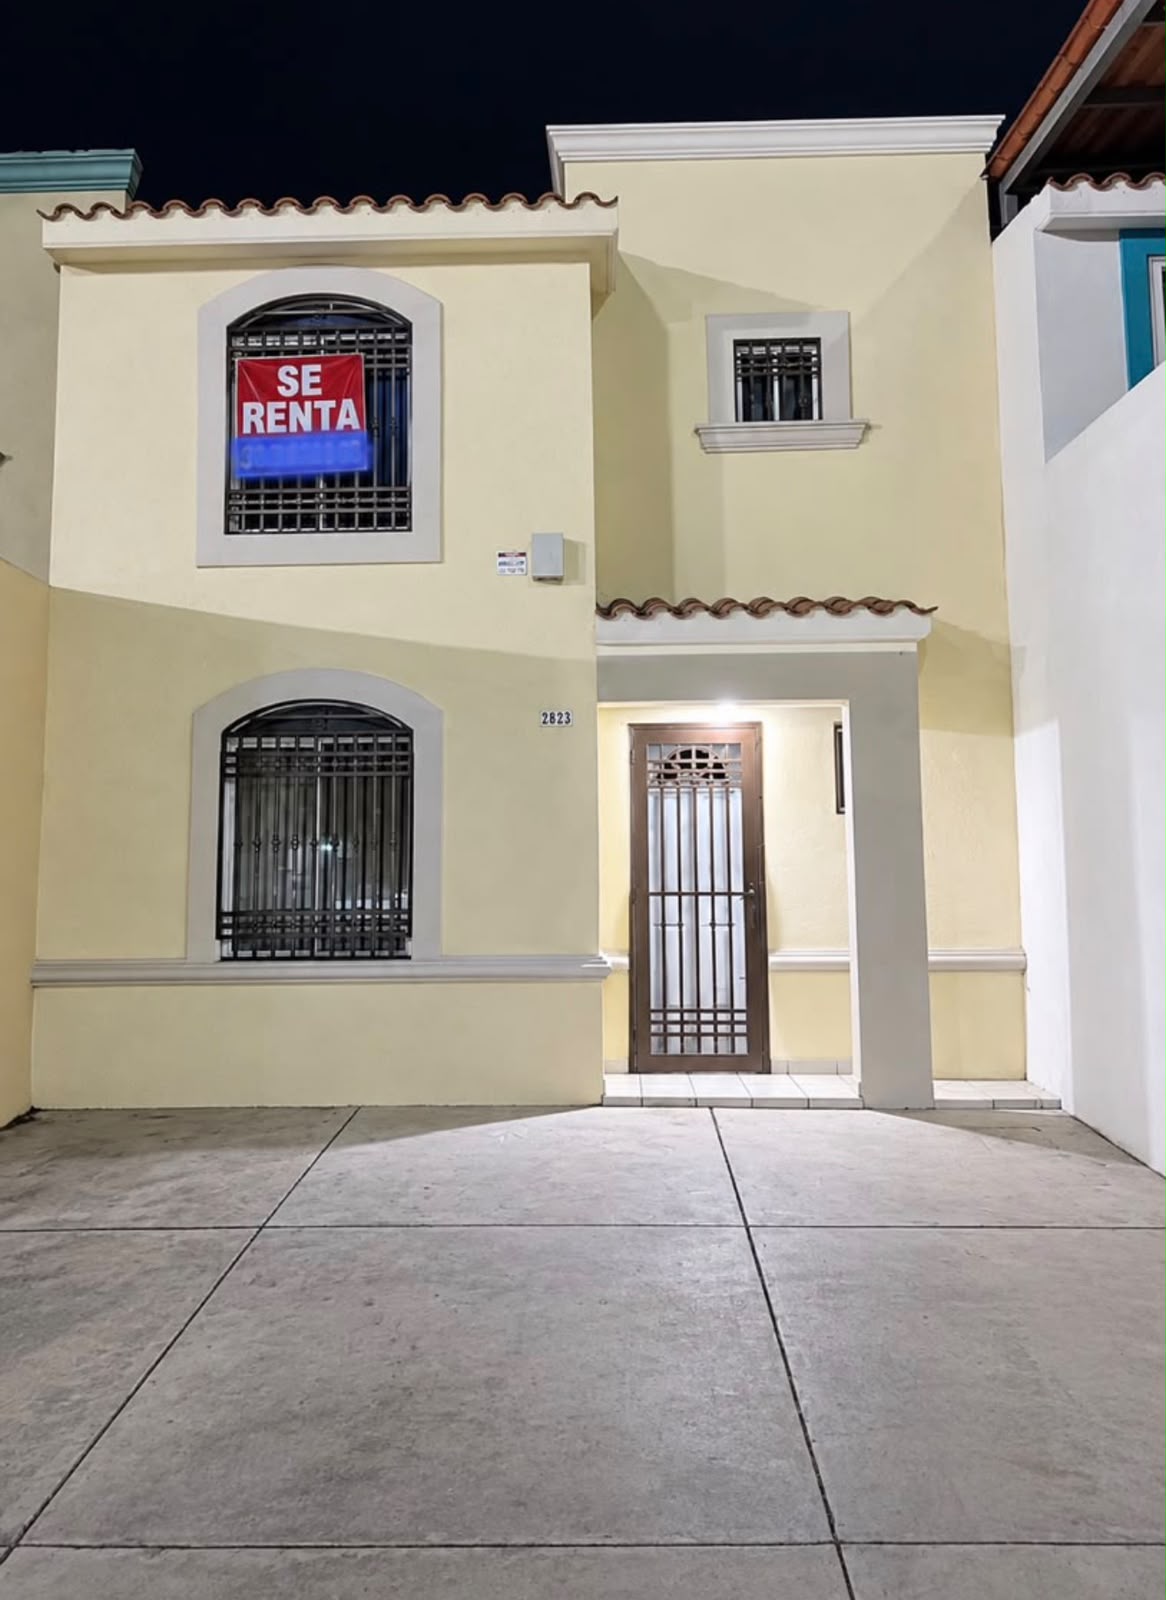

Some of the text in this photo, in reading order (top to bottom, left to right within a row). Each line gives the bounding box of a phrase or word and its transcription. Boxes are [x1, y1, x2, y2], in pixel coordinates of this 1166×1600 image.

[277, 364, 322, 397] SE
[242, 398, 360, 434] RENTA
[542, 711, 571, 724] 2823
